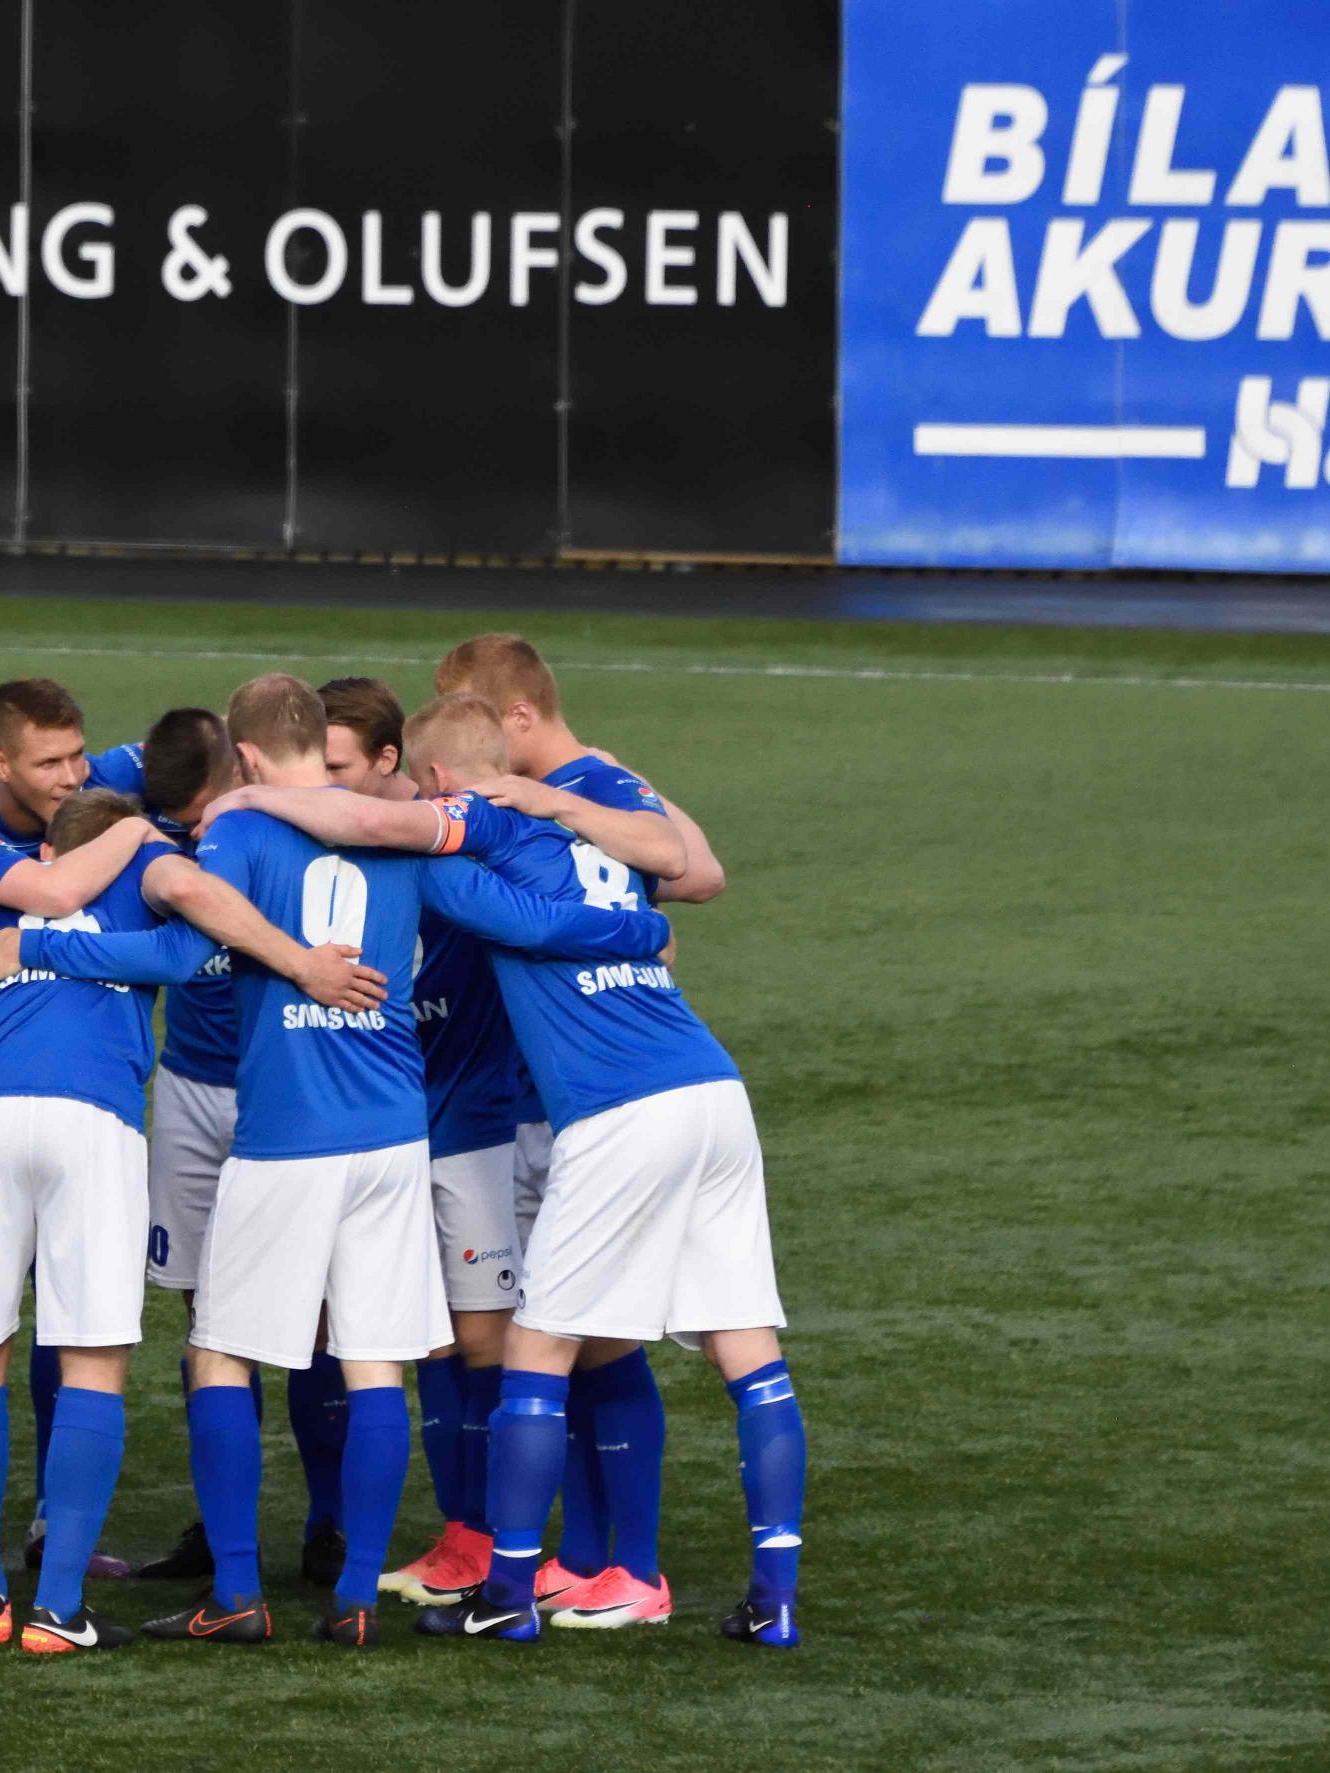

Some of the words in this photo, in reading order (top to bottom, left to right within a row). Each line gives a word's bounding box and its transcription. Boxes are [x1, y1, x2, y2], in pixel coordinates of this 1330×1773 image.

[162, 206, 230, 301] &
[266, 208, 788, 306] OLUFSEN
[1226, 376, 1330, 489] H
